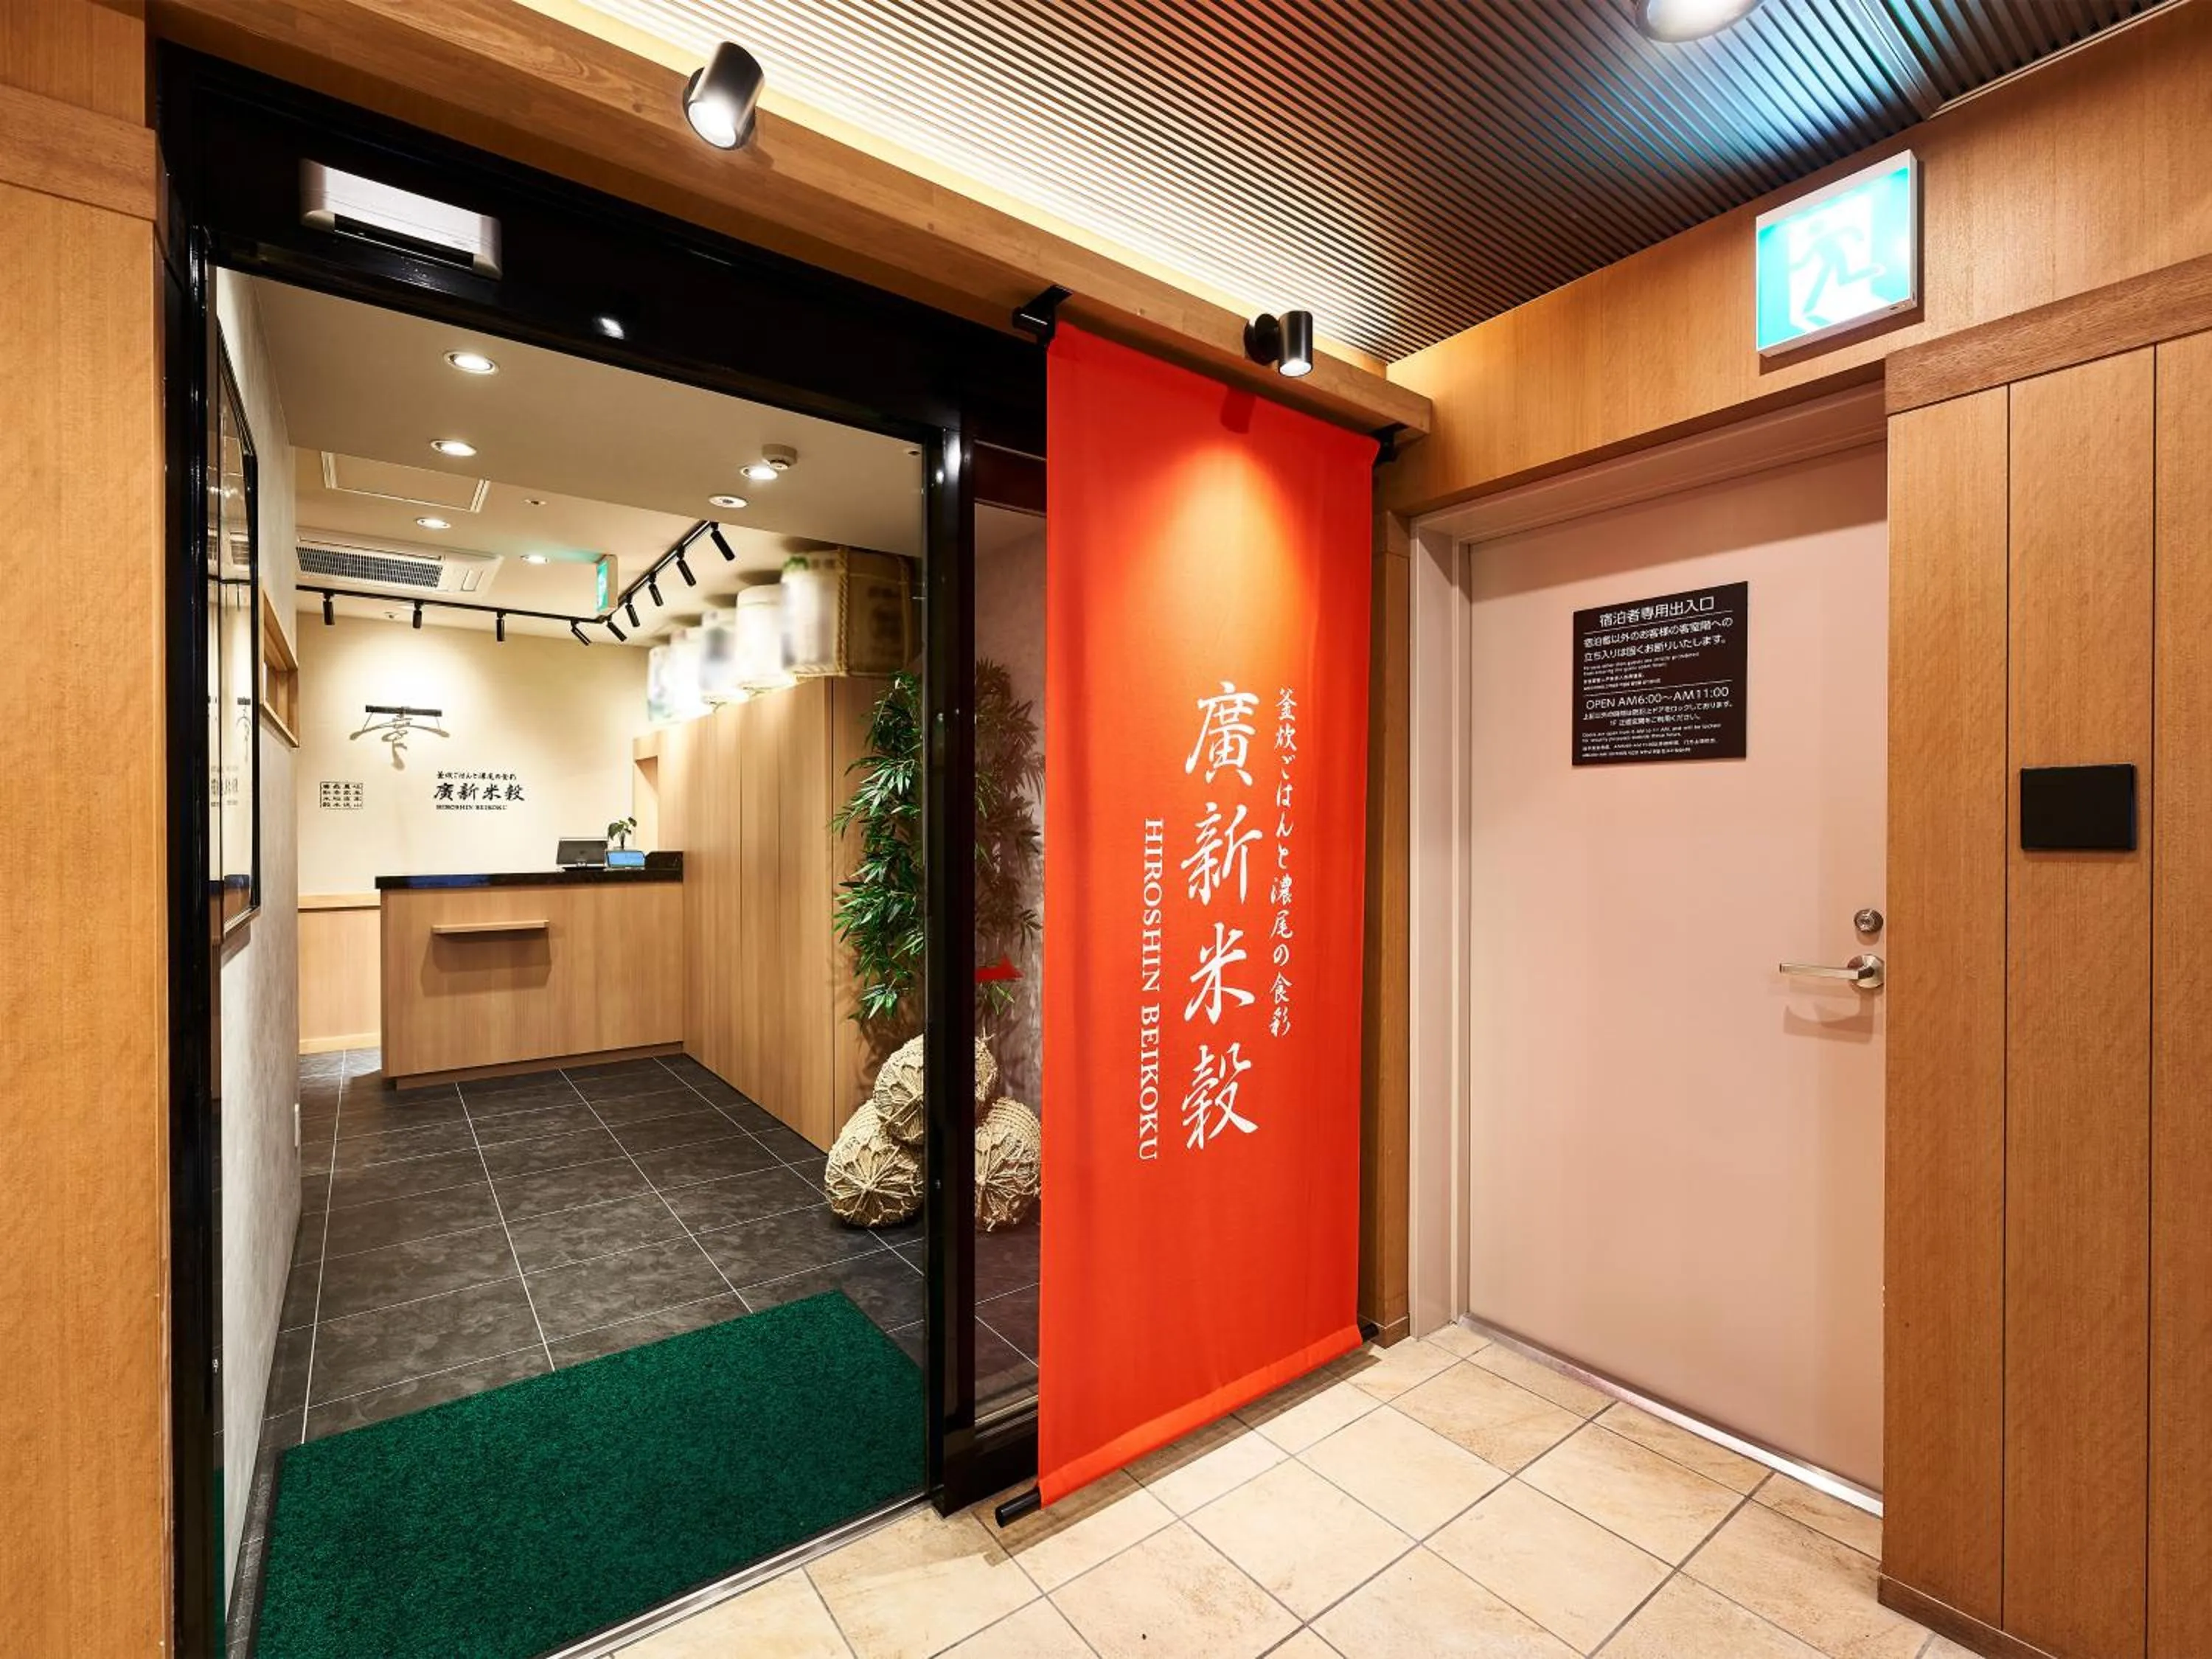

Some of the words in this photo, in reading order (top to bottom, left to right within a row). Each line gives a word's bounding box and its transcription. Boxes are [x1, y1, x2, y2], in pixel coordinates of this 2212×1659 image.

[1599, 597, 1714, 627] 宿泊者専用出入口
[1586, 698, 1615, 710] OPEN
[434, 782, 525, 801] 廣新米穀
[1270, 687, 1297, 1037] 釜炊ごはんと濃尾の食彩
[1142, 819, 1164, 992] HIROSHIN
[1180, 681, 1263, 1150] 廣新米穀
[1139, 1003, 1160, 1160] BEIKOKU
